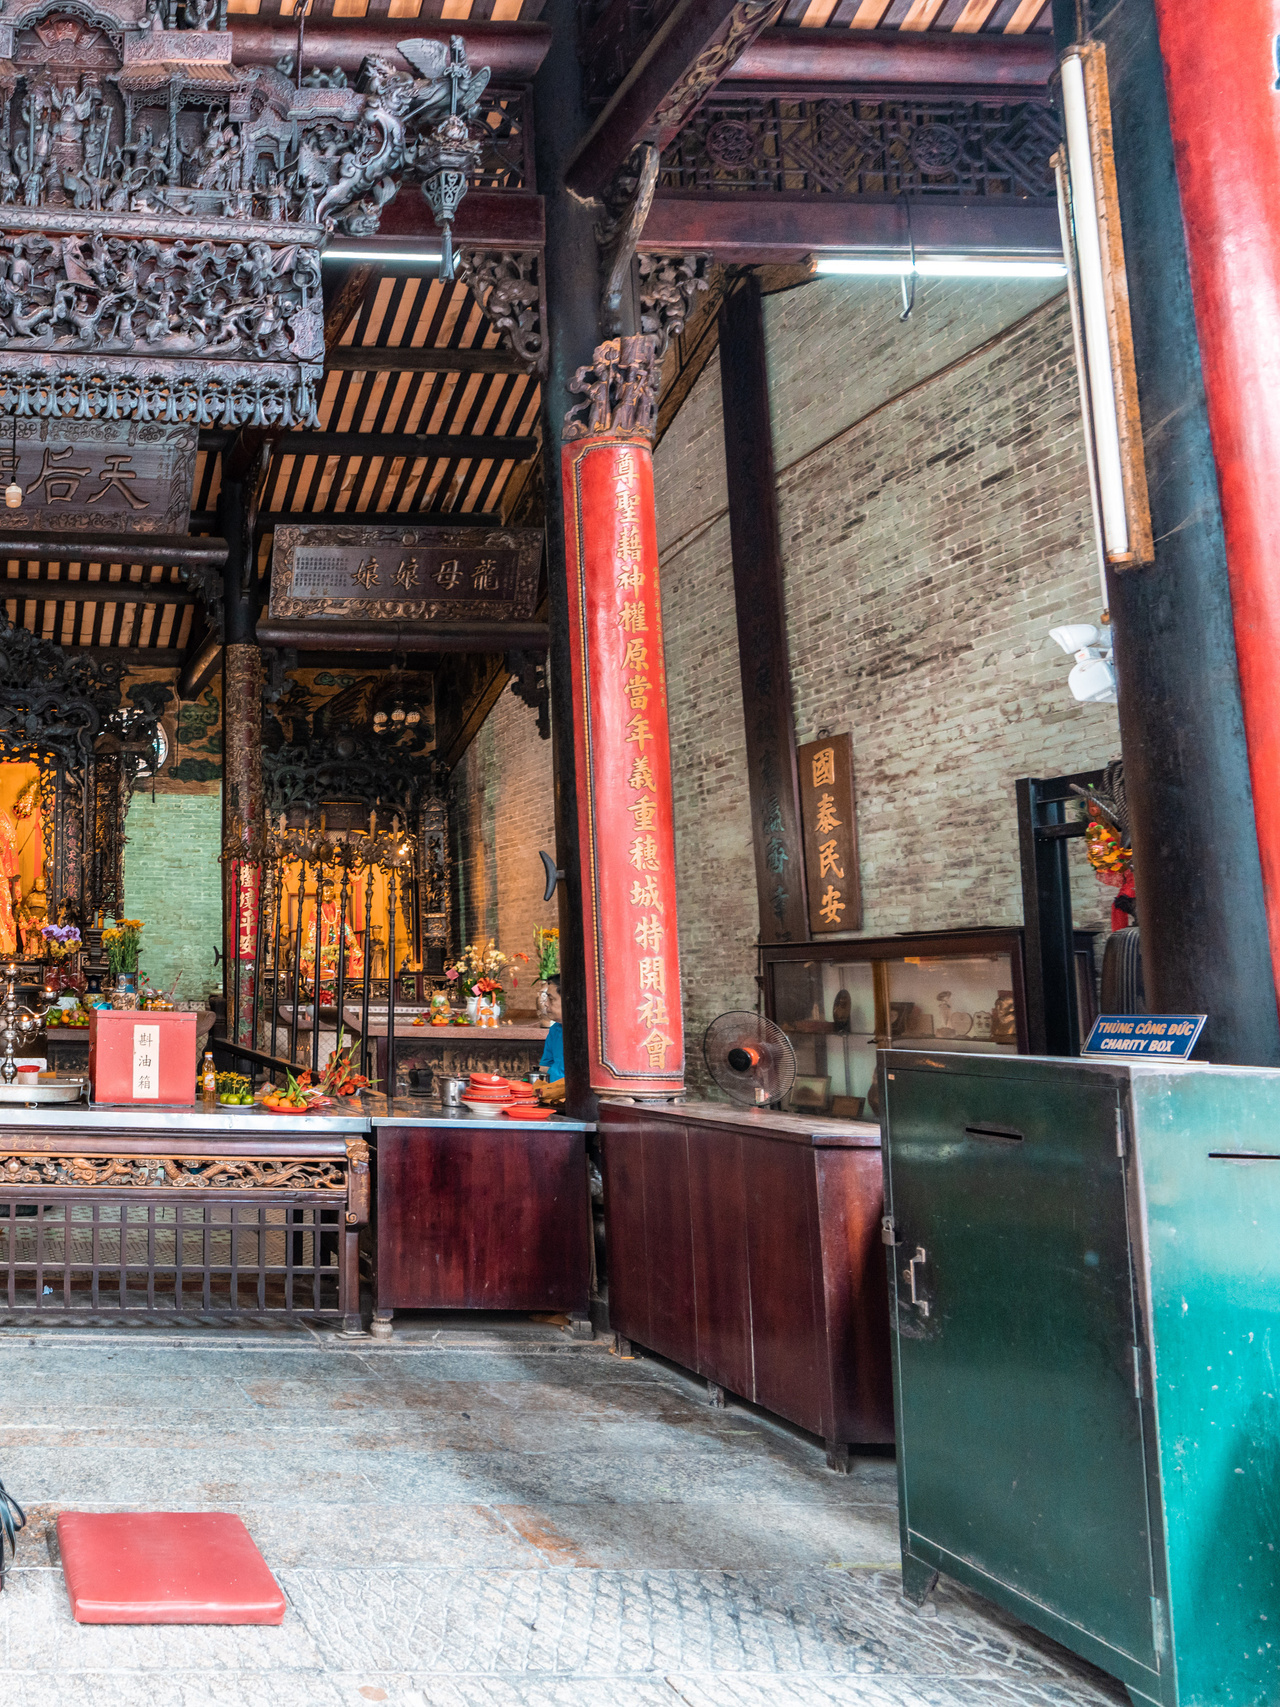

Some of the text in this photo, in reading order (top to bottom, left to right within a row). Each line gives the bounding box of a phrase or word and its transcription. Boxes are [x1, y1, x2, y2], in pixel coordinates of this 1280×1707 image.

[351, 556, 500, 591] 龍母娘娘
[812, 747, 846, 924] 國泰民安
[1098, 1020, 1195, 1036] THÙNG CÔNG ĐỨC
[1100, 1038, 1175, 1052] CHARITY BOX
